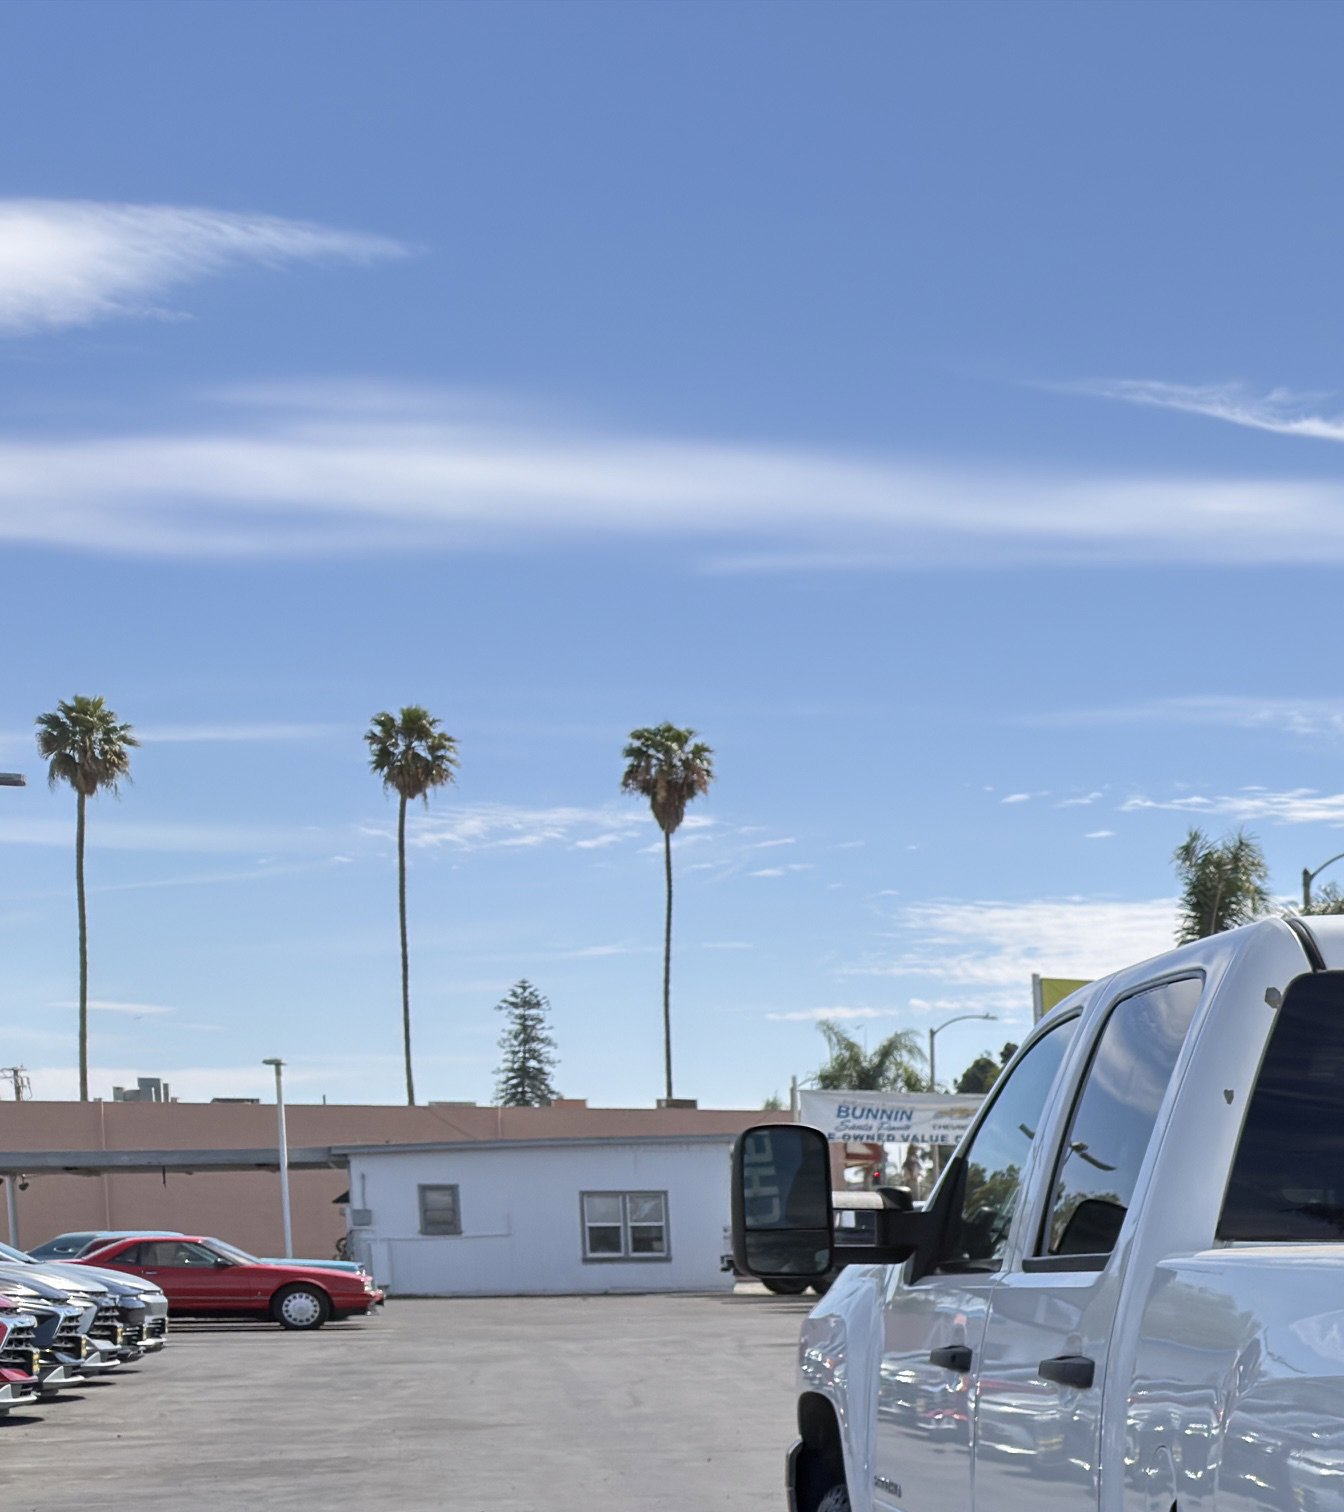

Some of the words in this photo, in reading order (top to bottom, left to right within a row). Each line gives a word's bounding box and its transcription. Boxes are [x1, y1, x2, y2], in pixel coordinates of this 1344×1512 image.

[836, 1104, 914, 1122] BUNNIN
[842, 1132, 896, 1142] OWNED
[901, 1133, 949, 1143] VALUE
